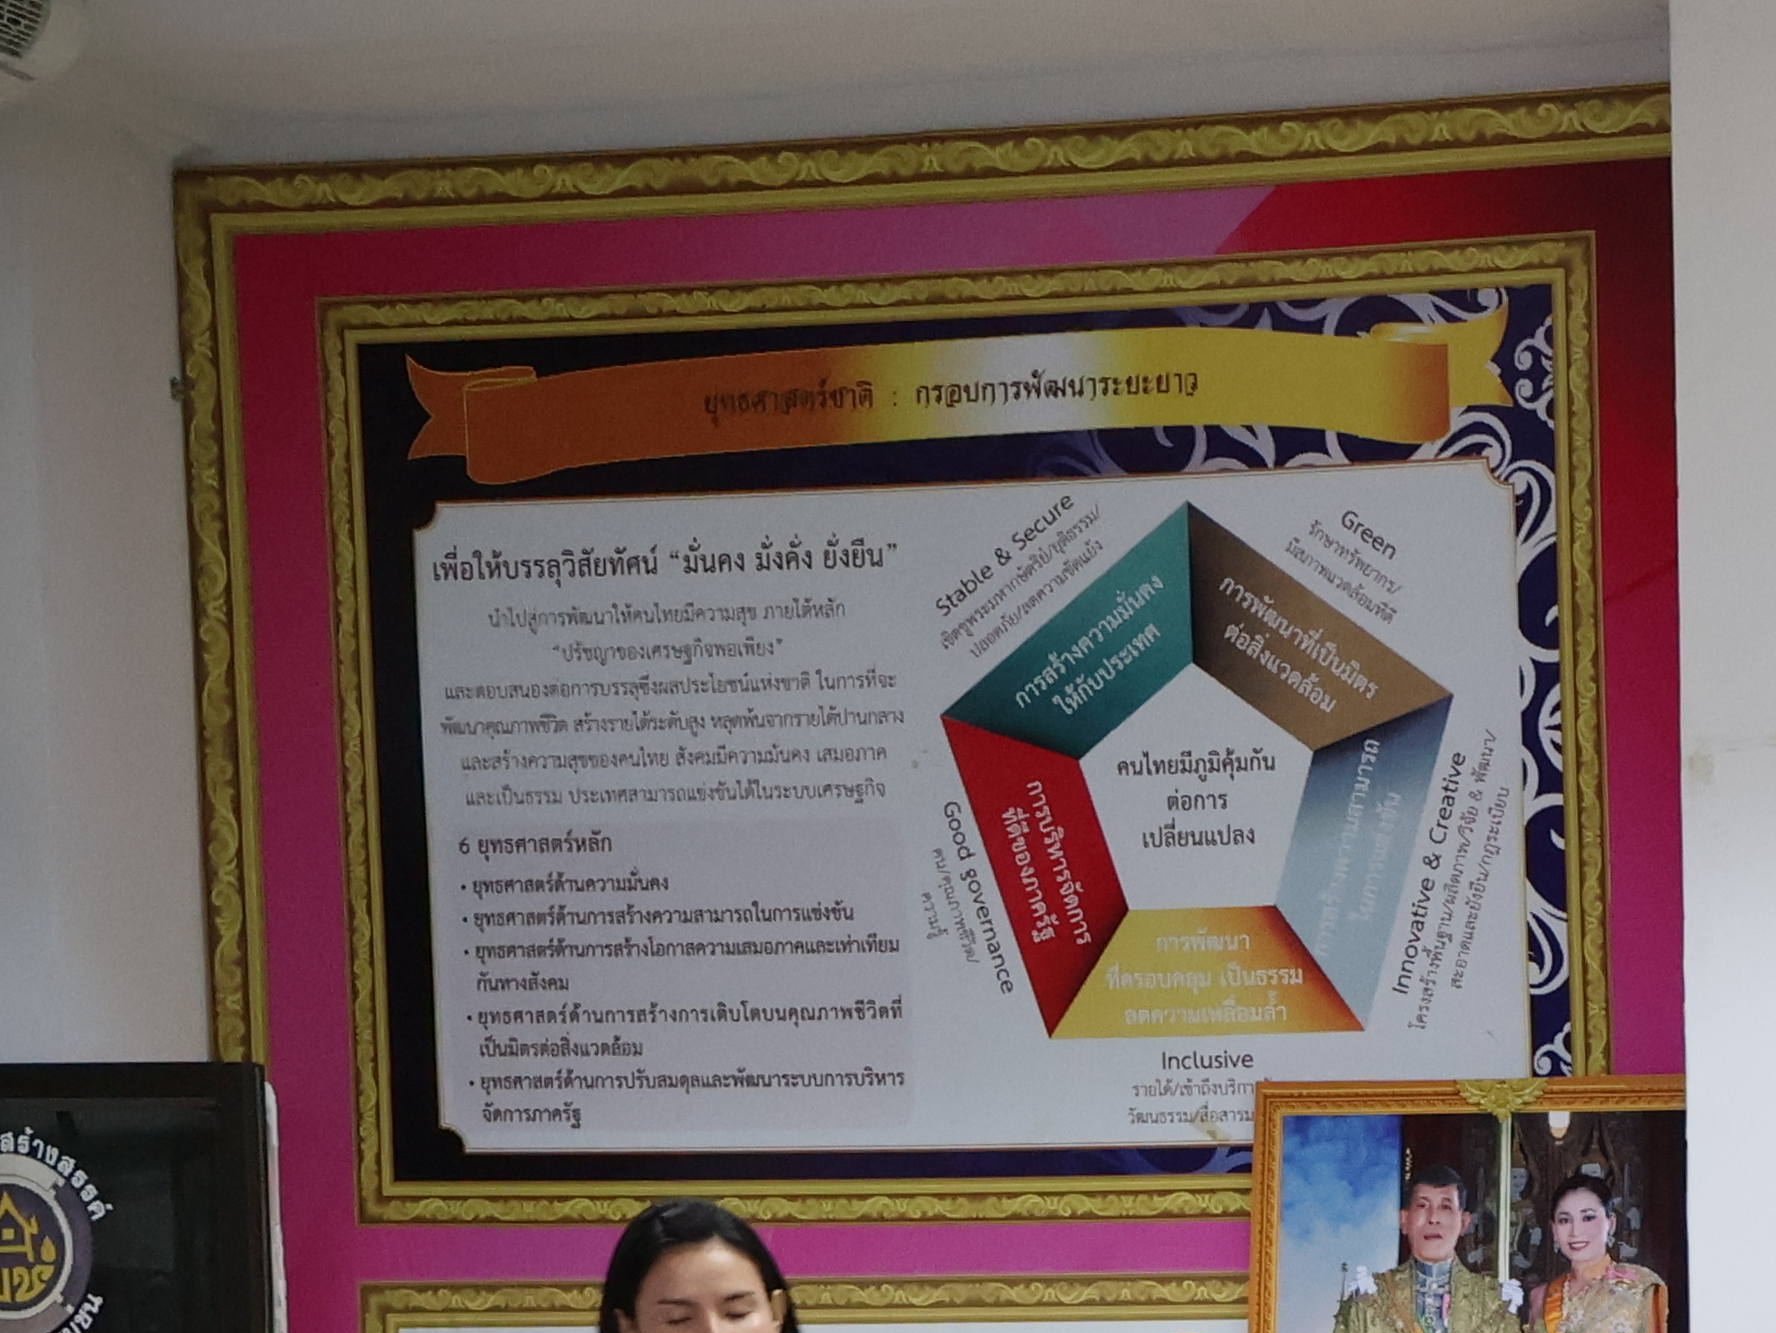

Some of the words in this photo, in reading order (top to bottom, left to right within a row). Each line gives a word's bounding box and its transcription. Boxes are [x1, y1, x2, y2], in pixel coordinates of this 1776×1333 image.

[915, 368, 1198, 408] กรอบการพัฒนาระยะยาว
[1341, 510, 1396, 560] Green
[432, 545, 658, 588] เพื่อให้บรรลุวิสัยทัศน์
[756, 534, 813, 571] มั่งคั่ง
[936, 563, 994, 617] Stable
[994, 547, 1012, 566] &
[1011, 494, 1075, 551] Secure
[1015, 575, 1165, 709] การสร้างความมั่นคง
[1219, 577, 1378, 700] การพัฒนาที่เป็นมิตร
[1052, 623, 1161, 715] ให้กับประเทศ
[1224, 622, 1336, 714] ต่อสิ่งแวดล้อม
[1117, 748, 1276, 782] คนไทยมีภูมิคุ้มกัน
[1166, 789, 1228, 811] ต่อการ
[1429, 751, 1466, 845] Creative
[458, 837, 471, 855] 6
[478, 829, 612, 862] ยุทธศาสตร์หลัก
[1142, 817, 1256, 849] เปลี่ยนแปลง
[1002, 807, 1060, 943] ที่ดีของภาครัฐ
[1026, 780, 1092, 945] การบริหารจัดการ
[1424, 853, 1442, 870] &
[472, 866, 669, 900] ยุทธศาสตร์ด้านความมั่นคง
[944, 801, 976, 861] Good
[960, 868, 1014, 994] governance
[474, 900, 854, 933] ยุทธศาสตร์ด้านการสร้างความสามารถในการแข่งขัน
[1391, 877, 1436, 995] Innovative
[476, 971, 569, 993] กันทางสังคม
[479, 1032, 643, 1058] เป็นมิตรต่อสิ่งแวดล้อม
[1161, 1050, 1254, 1070] Inclusive
[1132, 1077, 1255, 1097] รายได้/เข้าถึงบริกา
[482, 1101, 582, 1130] จัดการภาครัฐ
[1127, 1101, 1255, 1125] วัฒนธรรม/สื่อสารม
